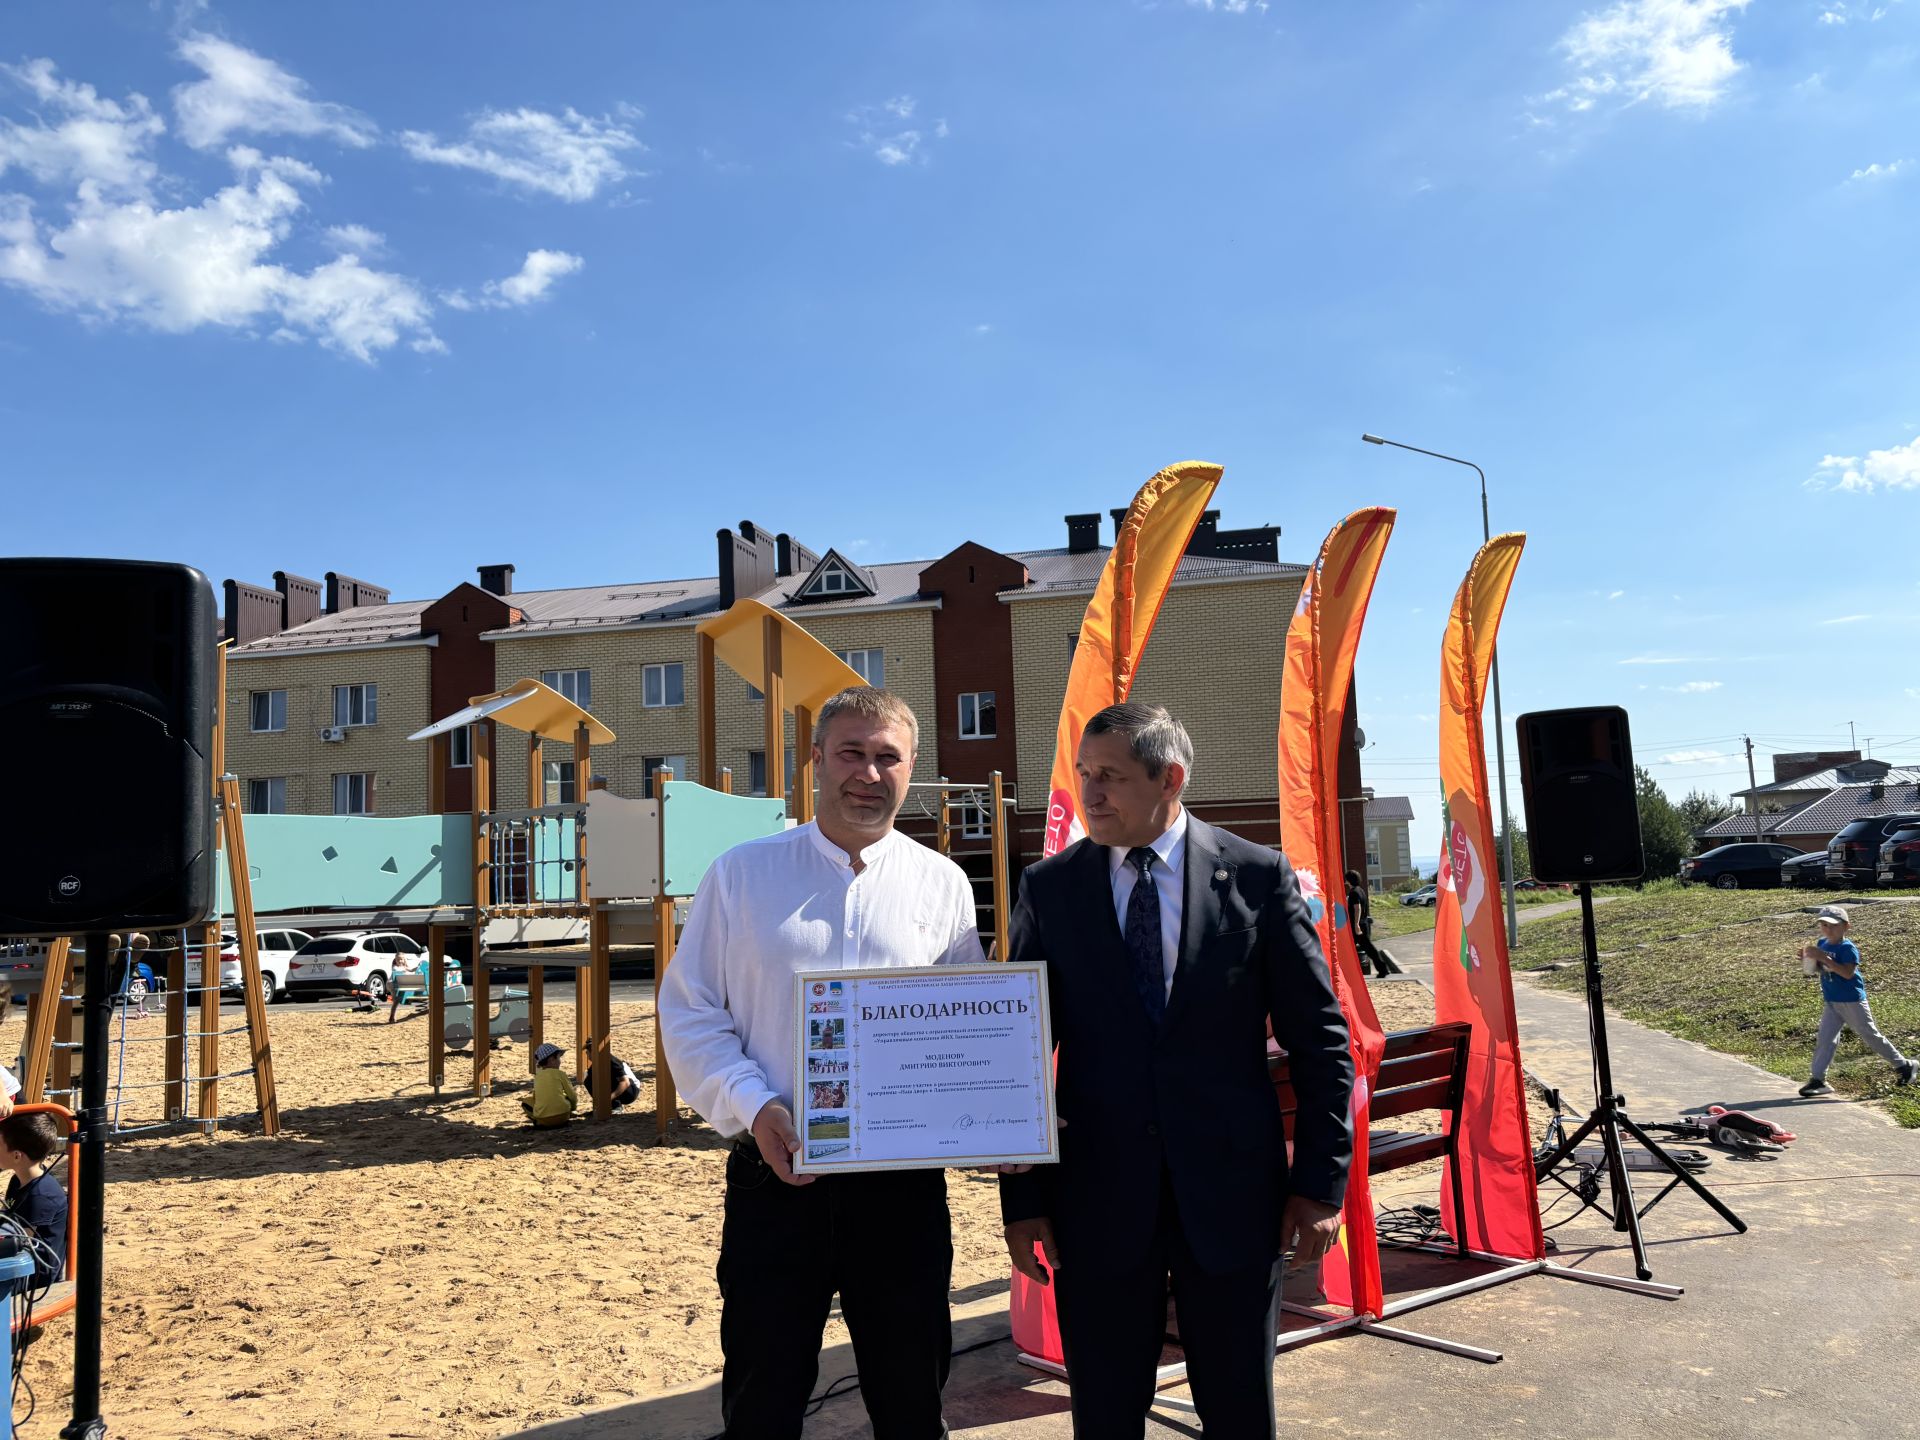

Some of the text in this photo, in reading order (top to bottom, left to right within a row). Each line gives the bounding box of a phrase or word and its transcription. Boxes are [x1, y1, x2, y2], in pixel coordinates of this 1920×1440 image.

[60, 881, 79, 890] RCF
[861, 1000, 1028, 1021] БЛАГОДАРНОСТЬ
[925, 1052, 964, 1060] МОДЕНОВУ
[899, 1059, 991, 1070] ДМИТРИЮ ВИКТОРОВИЧУ
